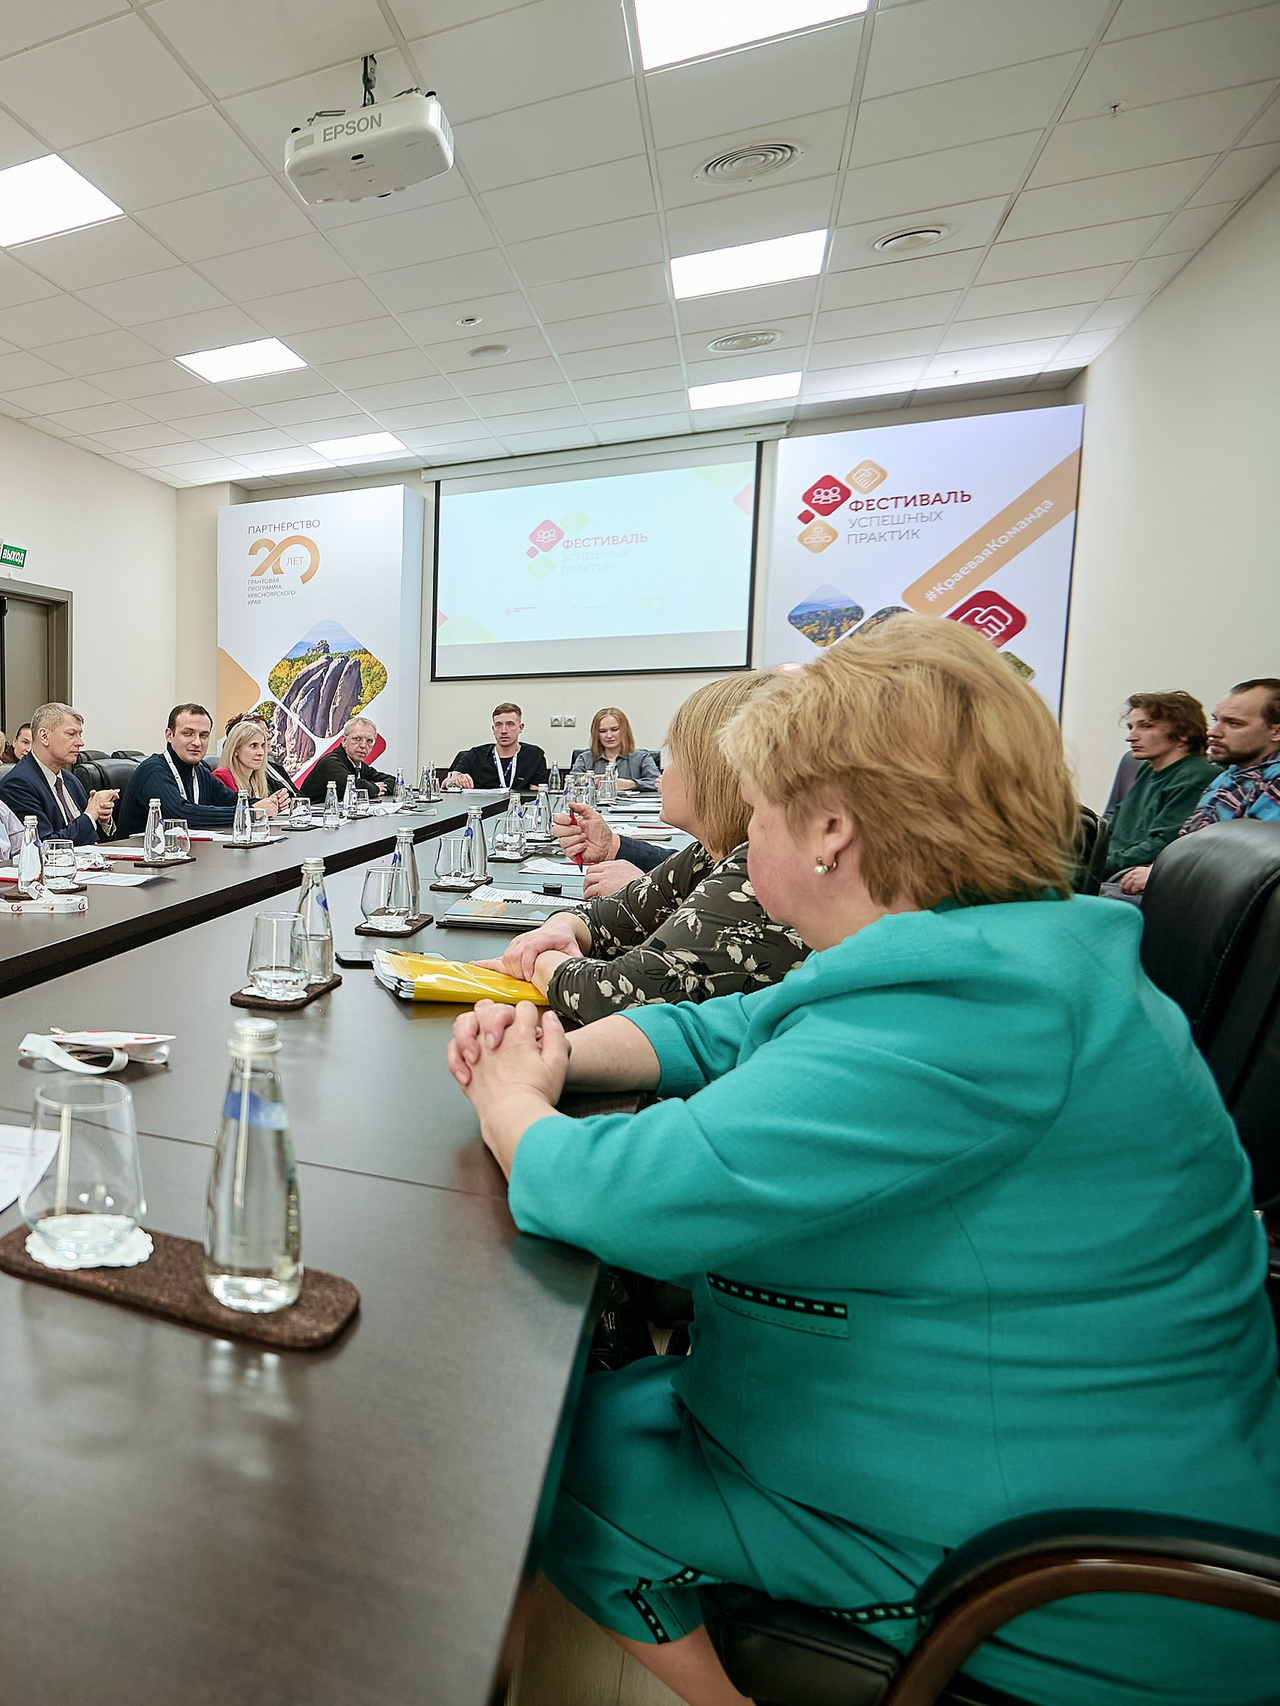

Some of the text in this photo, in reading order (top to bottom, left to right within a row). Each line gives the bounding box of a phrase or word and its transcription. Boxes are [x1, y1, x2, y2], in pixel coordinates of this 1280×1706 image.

[323, 113, 382, 143] EPSON
[848, 490, 972, 512] ФЕСТИВАЛЬ
[848, 511, 943, 529] УСПЕШНЫХ
[562, 533, 648, 549] ФЕСТИВАЛЬ
[847, 529, 920, 544] ПРАКТИК
[2, 549, 25, 566] ВЫХОД
[924, 499, 1054, 602] #КраеваяКоманда
[248, 535, 320, 584] 20
[286, 556, 305, 566] ЛЕТ
[248, 584, 282, 592] ПРОГРАММА
[248, 590, 296, 599] КРАСНОЯРСКОГО
